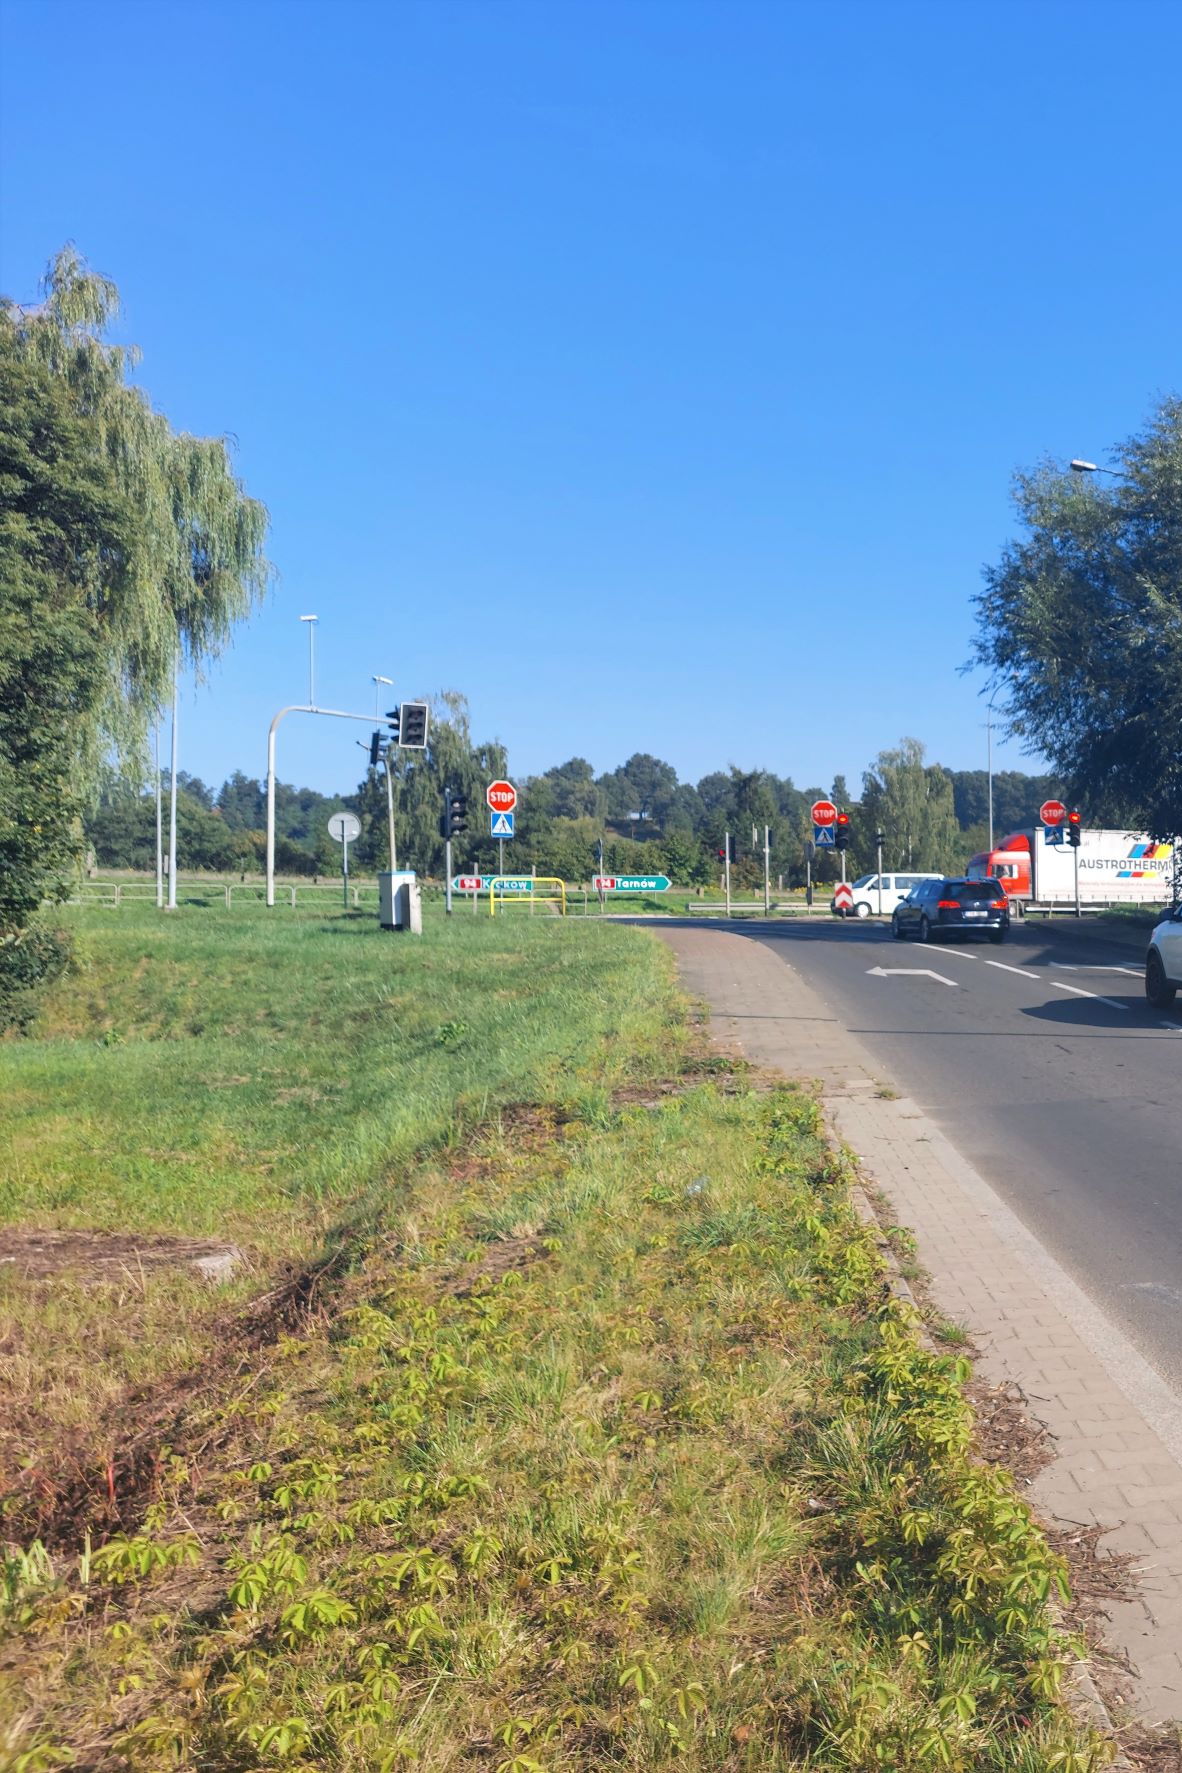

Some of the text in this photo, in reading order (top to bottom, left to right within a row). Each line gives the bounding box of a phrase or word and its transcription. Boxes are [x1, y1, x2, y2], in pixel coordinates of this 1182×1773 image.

[490, 791, 514, 803] STOP
[813, 809, 835, 819] STOP
[1042, 809, 1064, 818] STOP
[1078, 859, 1169, 871] AUSTROTHERM
[463, 879, 477, 889] 94
[616, 877, 657, 888] Tarnów
